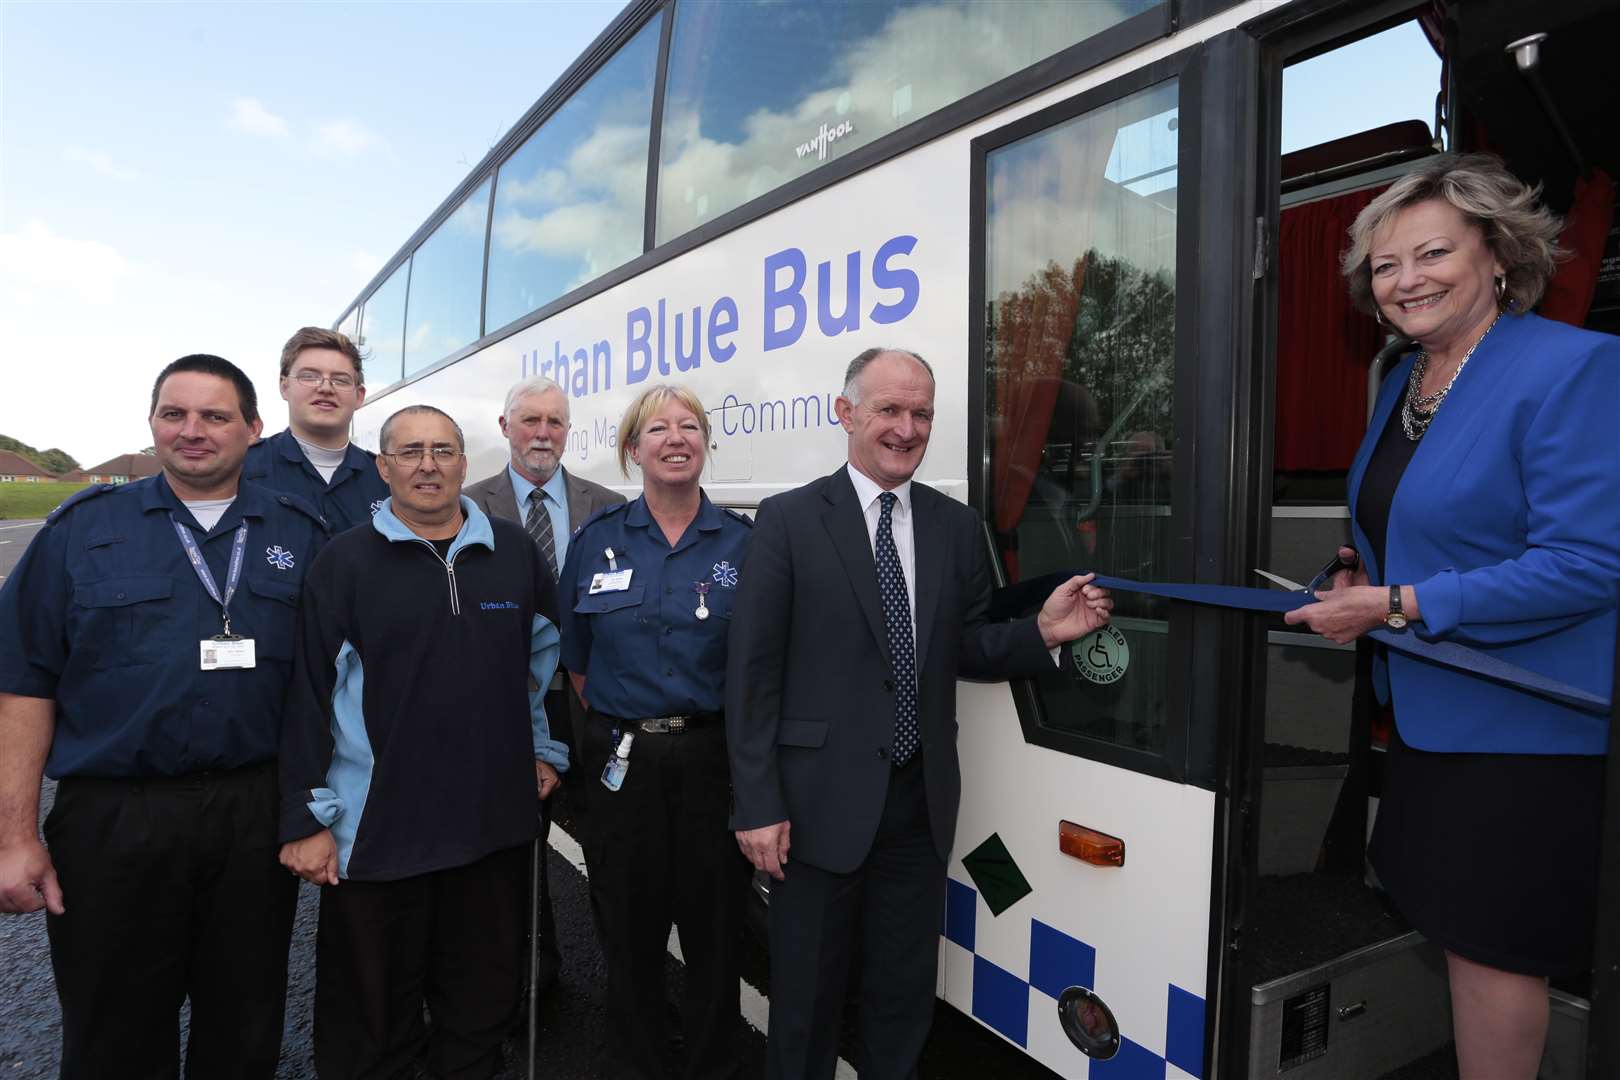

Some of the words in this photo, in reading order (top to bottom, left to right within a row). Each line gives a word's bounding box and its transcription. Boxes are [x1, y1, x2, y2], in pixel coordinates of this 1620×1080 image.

[625, 296, 739, 386] Blue
[763, 235, 920, 352] Bus
[722, 394, 840, 436] Commu
[1074, 654, 1124, 682] PASSENGER
